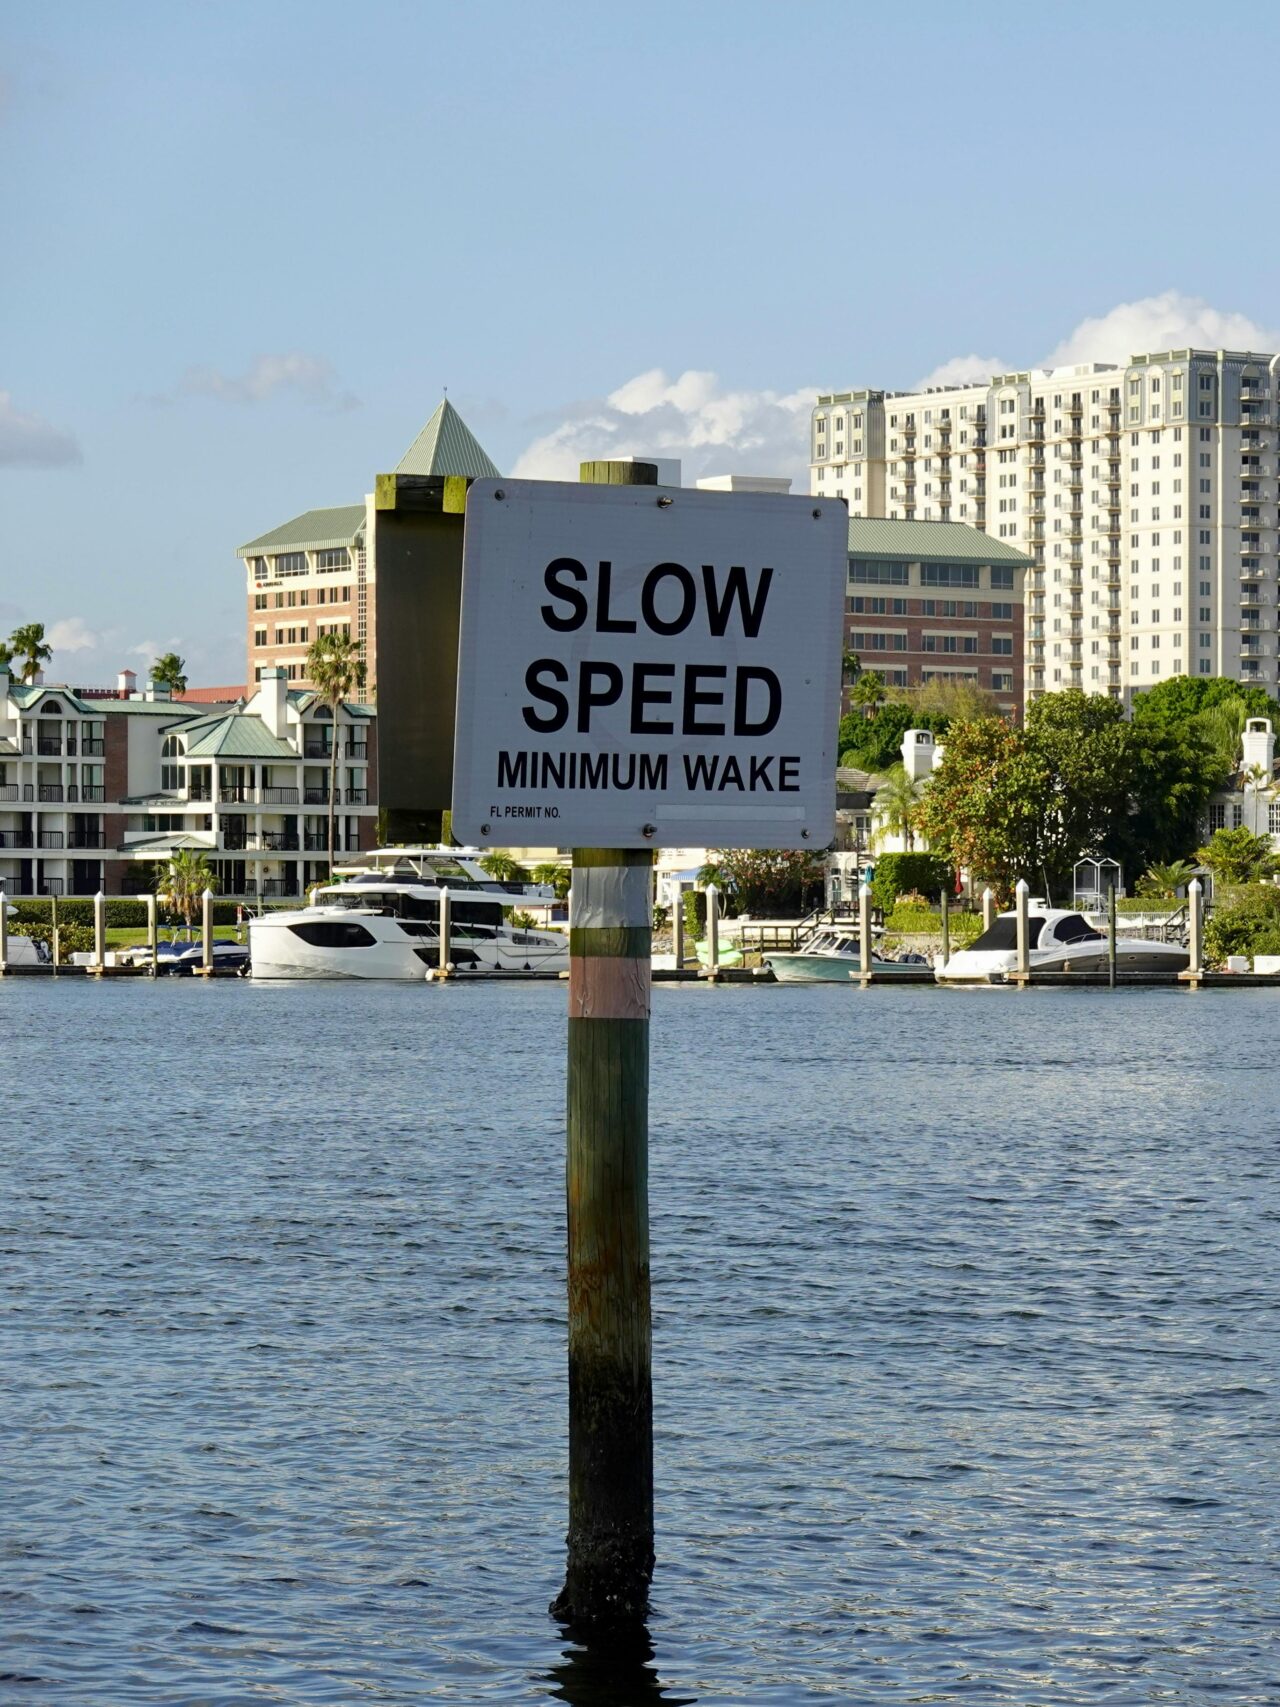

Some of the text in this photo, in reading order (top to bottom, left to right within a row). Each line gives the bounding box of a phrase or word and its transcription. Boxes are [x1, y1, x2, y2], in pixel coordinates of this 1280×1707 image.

[540, 557, 774, 638] SLOW
[522, 658, 782, 737] SPEED
[497, 750, 801, 792] MINIMUM WAKE
[490, 805, 561, 820] FL PERMIT NO.
